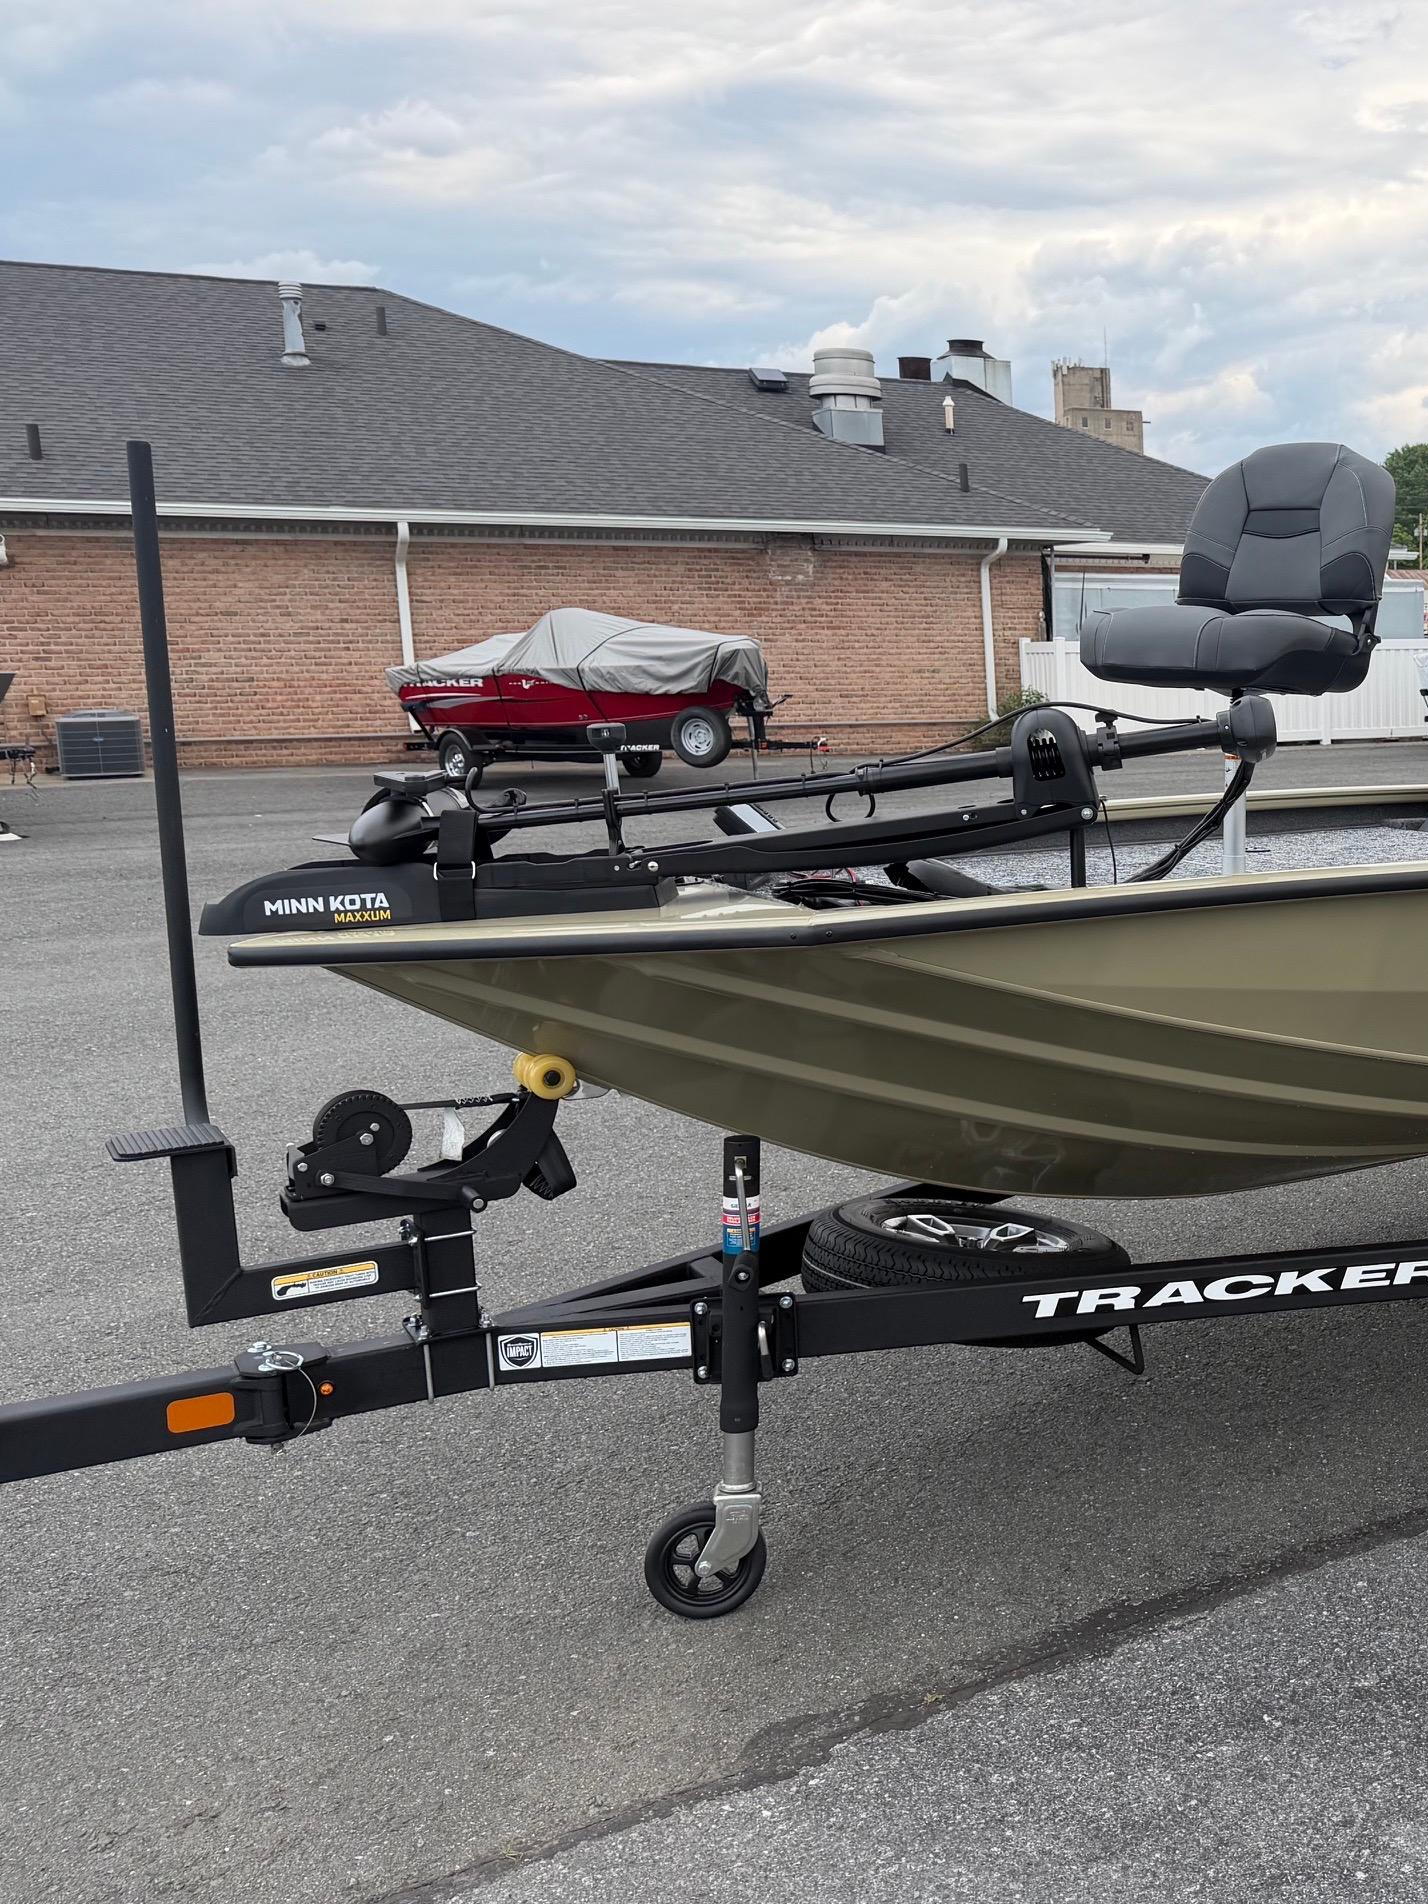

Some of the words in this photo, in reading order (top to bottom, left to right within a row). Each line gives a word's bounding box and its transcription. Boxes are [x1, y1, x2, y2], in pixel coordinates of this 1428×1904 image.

[403, 678, 484, 688] ACKER
[264, 897, 325, 916] MINN
[329, 893, 390, 912] KOTA
[334, 909, 391, 924] MAXXUM
[506, 1345, 533, 1358] IMPACT
